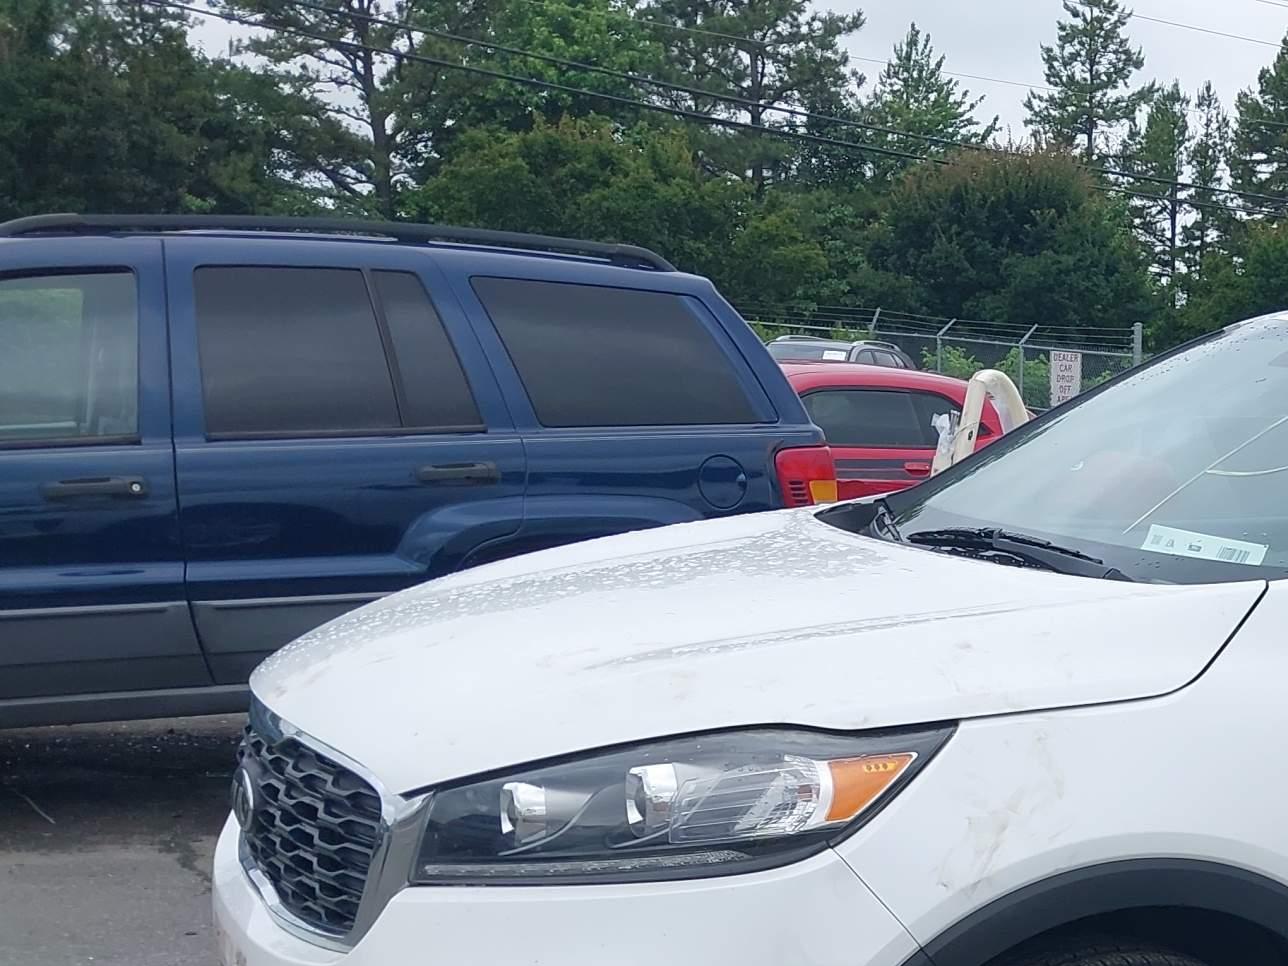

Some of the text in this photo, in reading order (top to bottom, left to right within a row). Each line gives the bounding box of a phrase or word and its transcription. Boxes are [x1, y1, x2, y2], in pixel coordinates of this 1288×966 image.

[1053, 353, 1079, 362] DEALER
[1060, 364, 1073, 373] CAR
[1056, 374, 1075, 383] DROP
